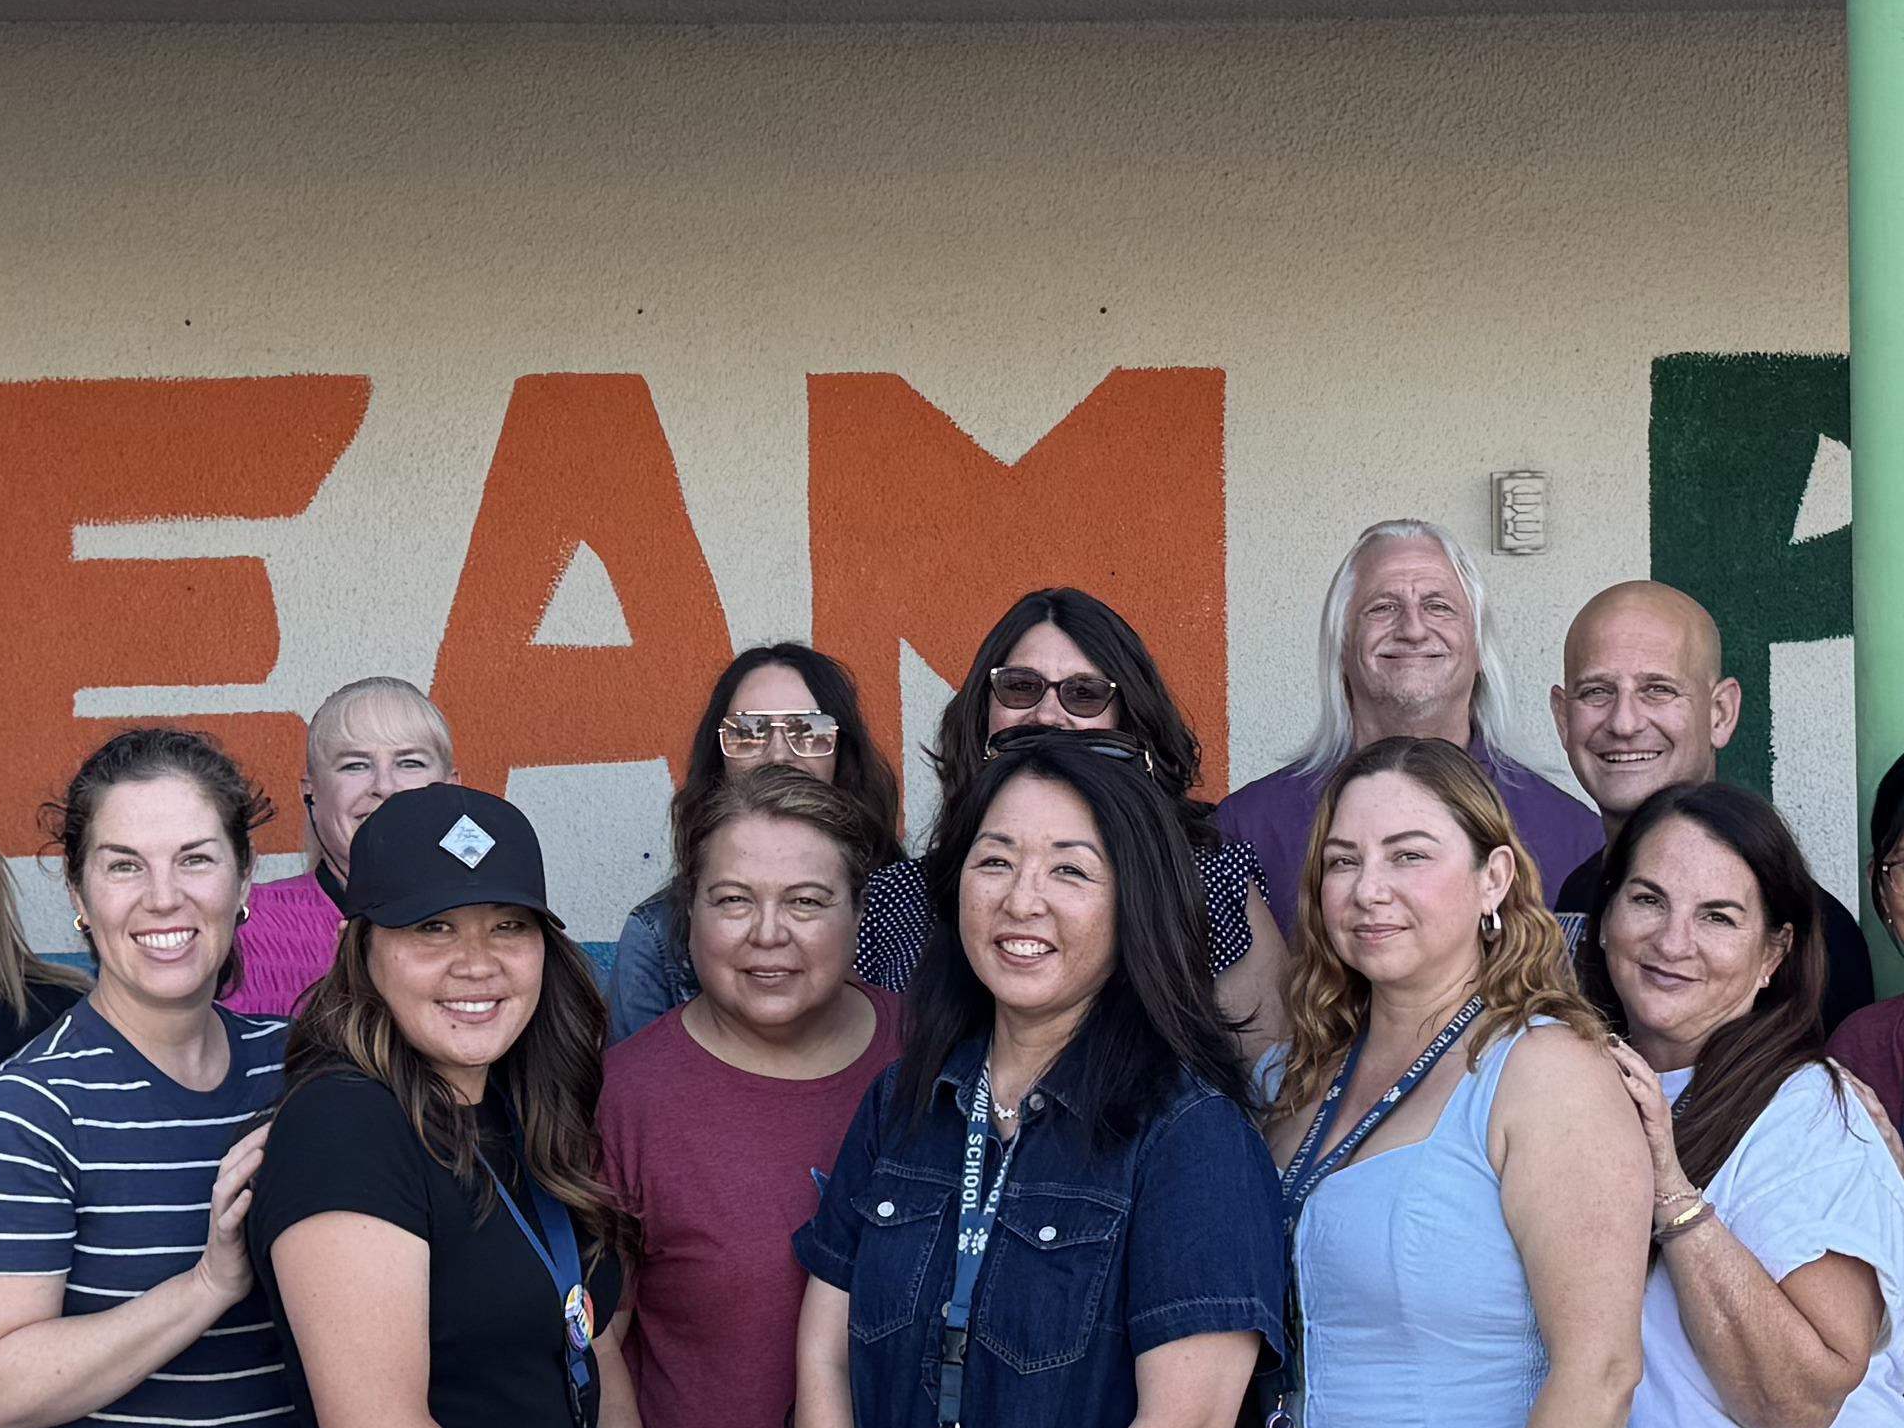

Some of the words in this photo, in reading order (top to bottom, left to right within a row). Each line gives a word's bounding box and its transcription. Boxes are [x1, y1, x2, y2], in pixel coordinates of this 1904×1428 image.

[1404, 1031, 1452, 1080] TOWNE
[1444, 994, 1486, 1035] TIGER
[960, 1132, 984, 1215] SCHOOL
[1336, 1110, 1381, 1158] TIGERS
